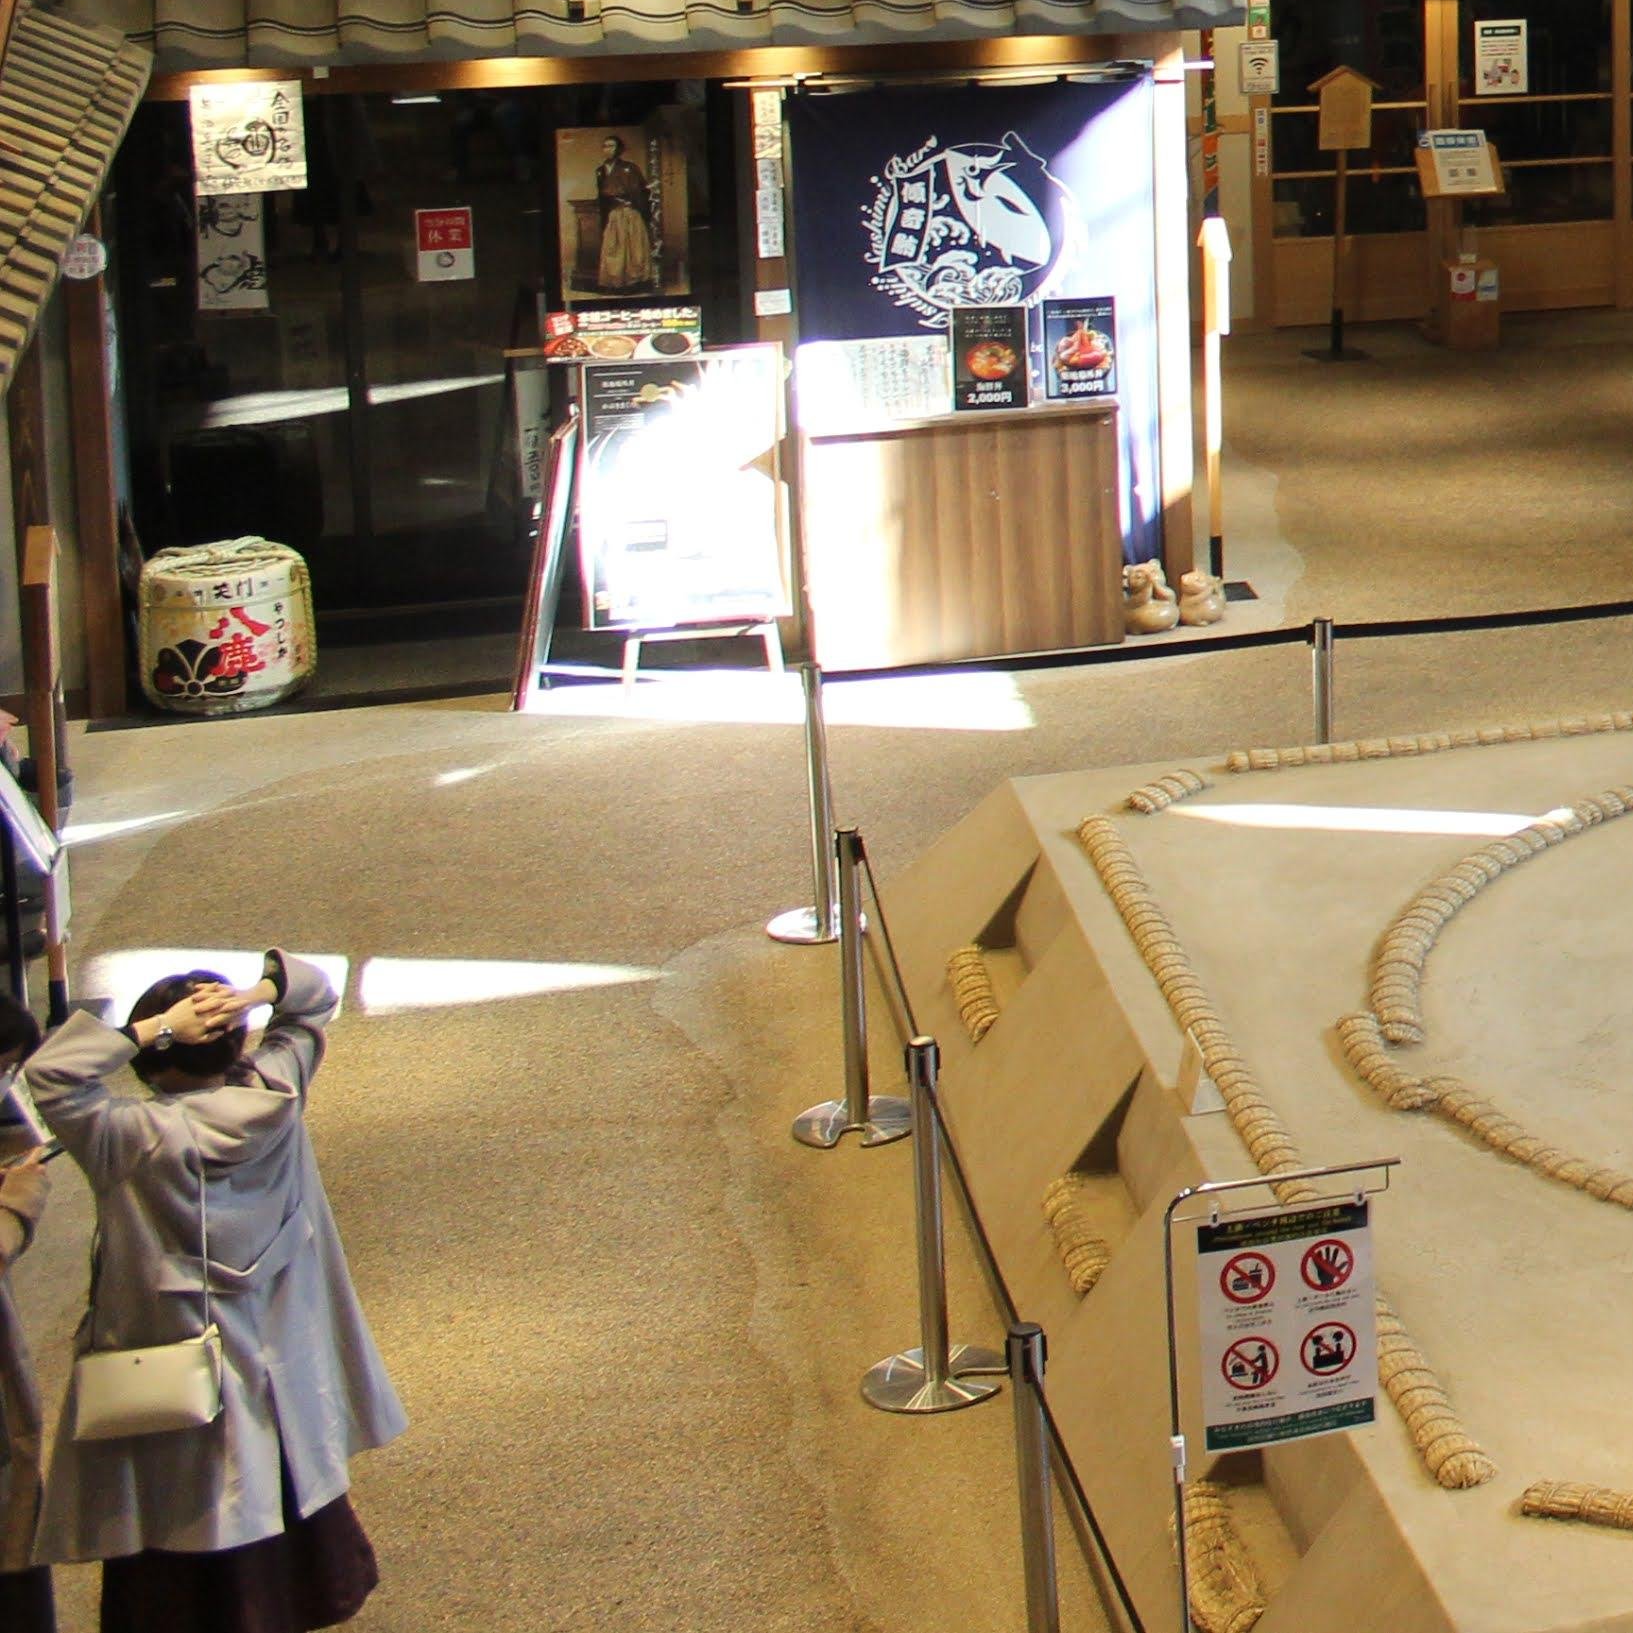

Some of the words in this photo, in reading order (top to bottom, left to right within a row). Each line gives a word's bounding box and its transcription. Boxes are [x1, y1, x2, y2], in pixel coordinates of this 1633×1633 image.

[860, 175, 892, 264] Sashimi
[885, 135, 938, 179] Bar
[870, 275, 951, 329] Tsukiji
[967, 391, 1012, 405] 2,000円
[1060, 381, 1104, 394] 3,000円
[208, 607, 272, 677] 八鹿
[273, 601, 288, 660] やつしか
